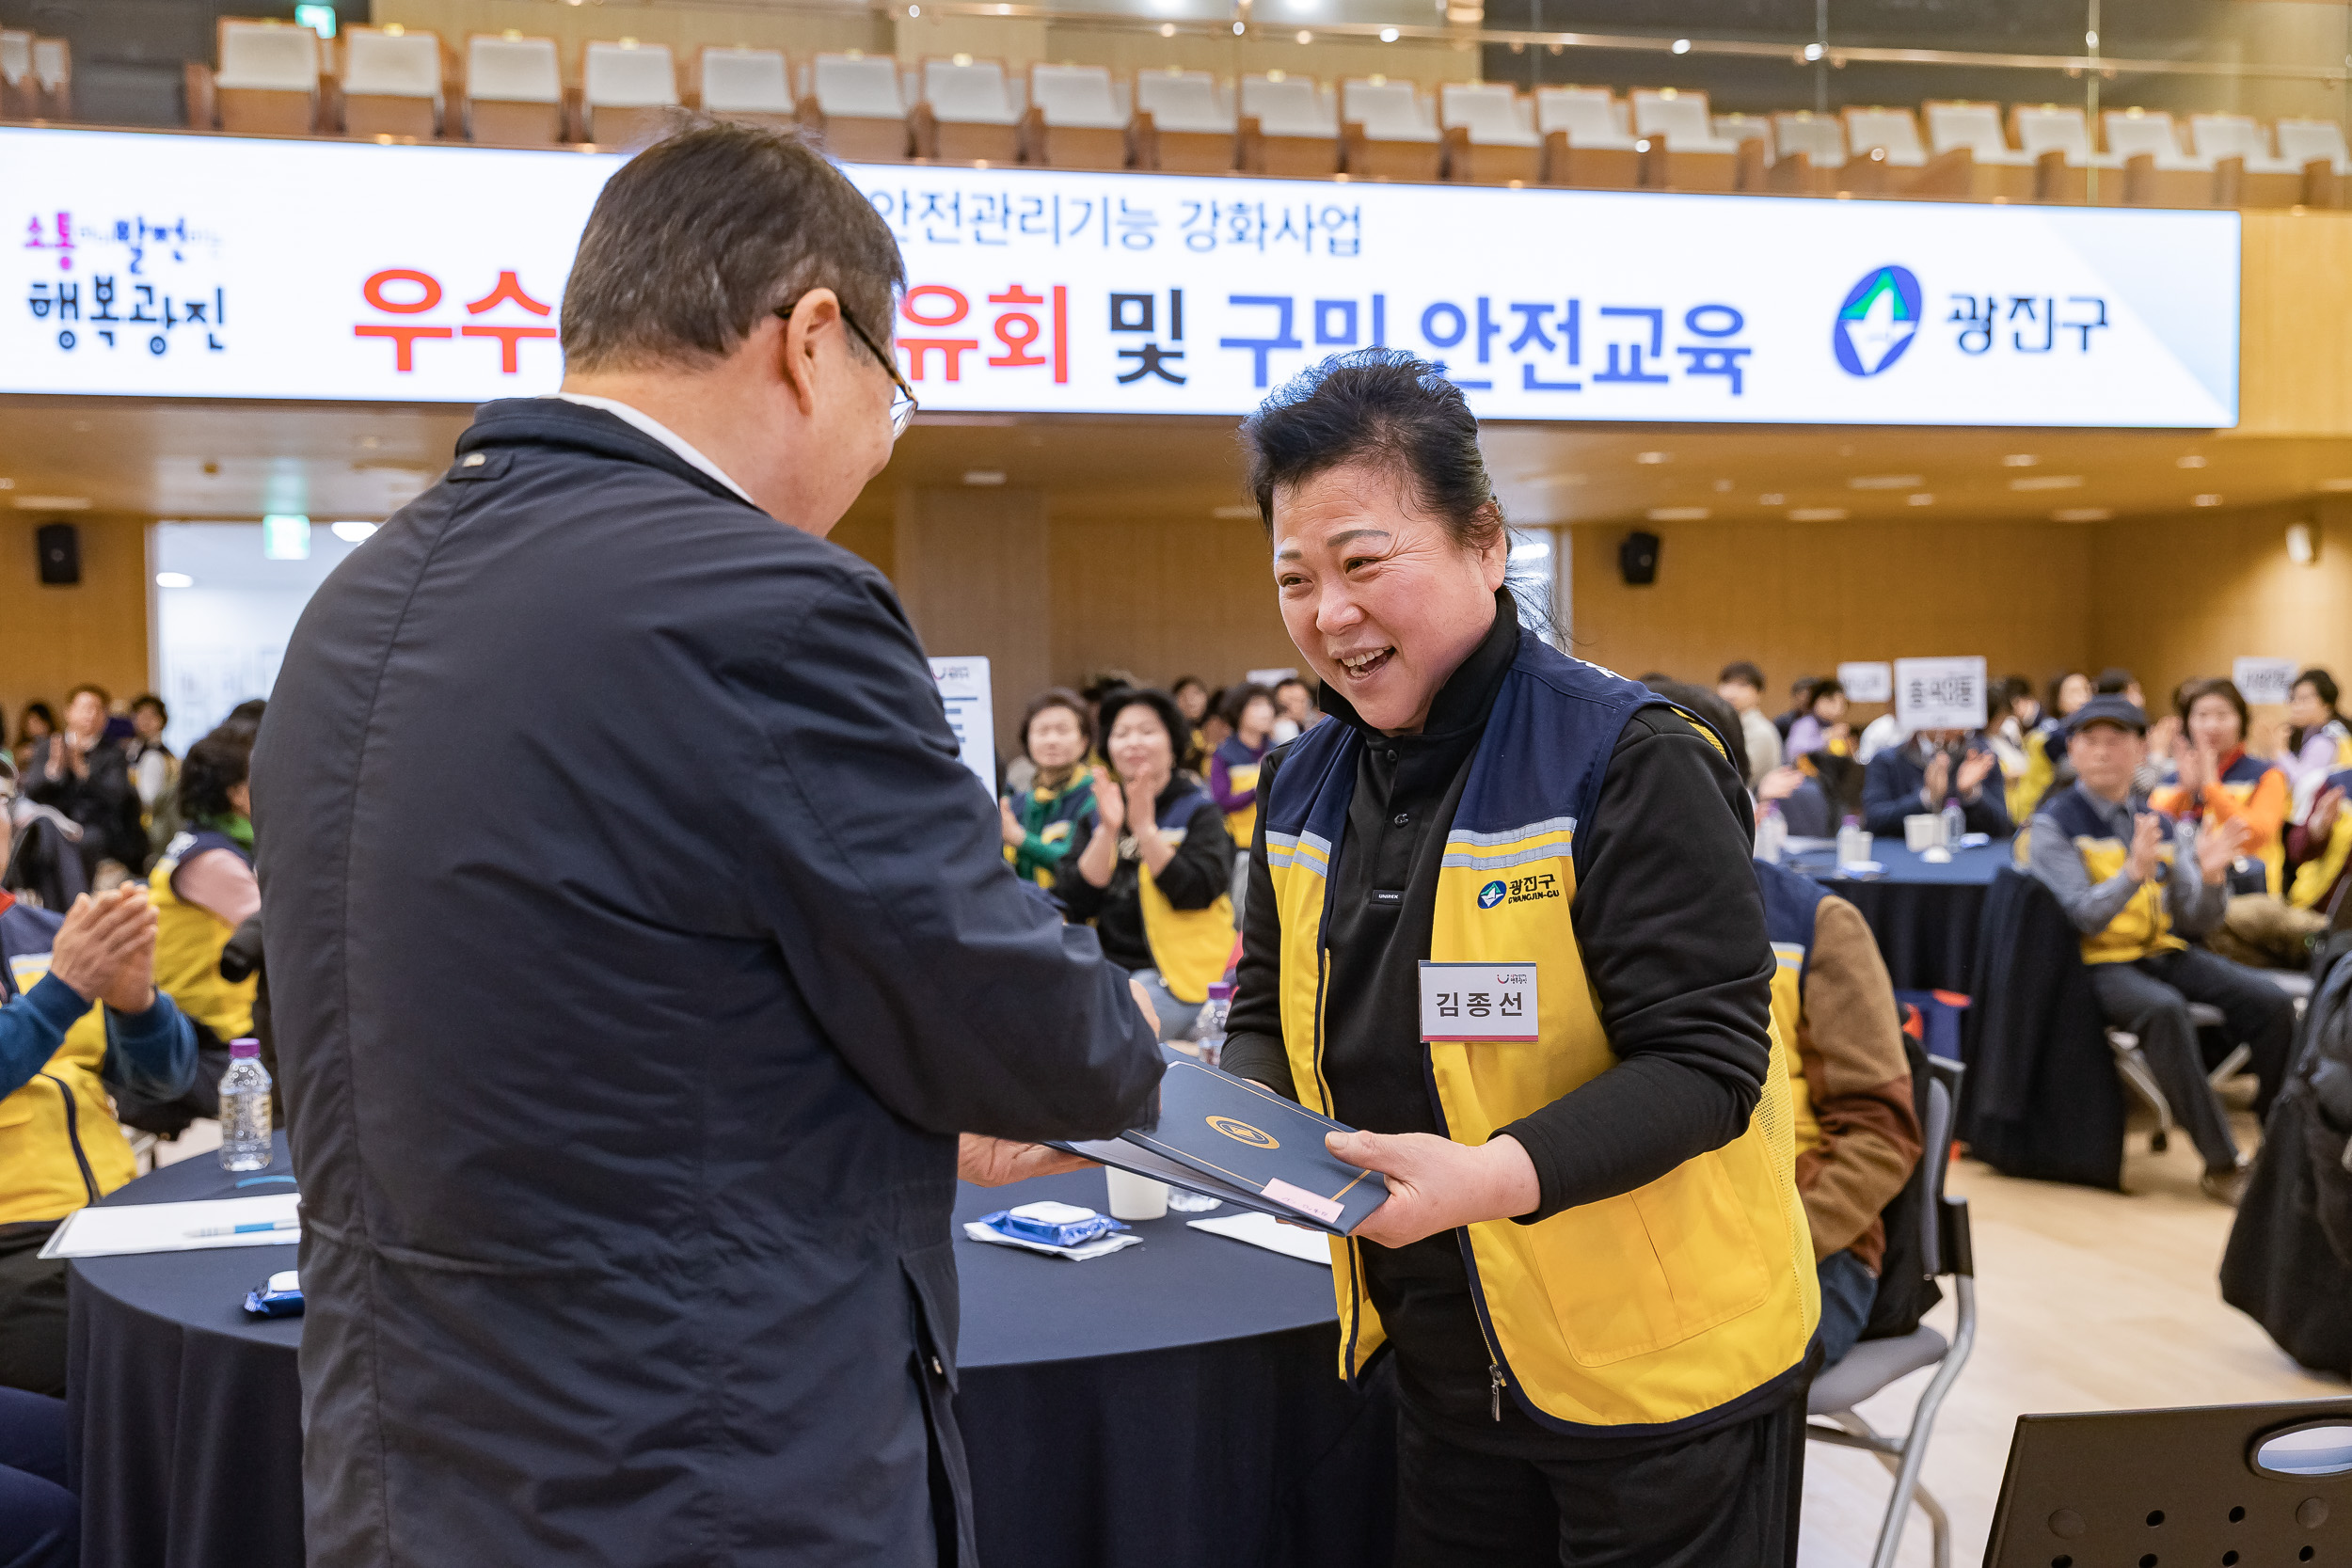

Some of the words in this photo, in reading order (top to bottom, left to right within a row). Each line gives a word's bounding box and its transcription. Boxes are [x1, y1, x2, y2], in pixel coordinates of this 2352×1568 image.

[1179, 198, 1361, 257] 강화사업
[28, 276, 225, 356] 행복광진
[1109, 289, 1187, 386] 및
[1421, 293, 1753, 396] 안전교육
[1947, 293, 2108, 355] 광진구
[1508, 890, 1559, 904] GWANGJIN-GU
[1509, 874, 1555, 895] 광진구
[1436, 991, 1523, 1018] 김종선
